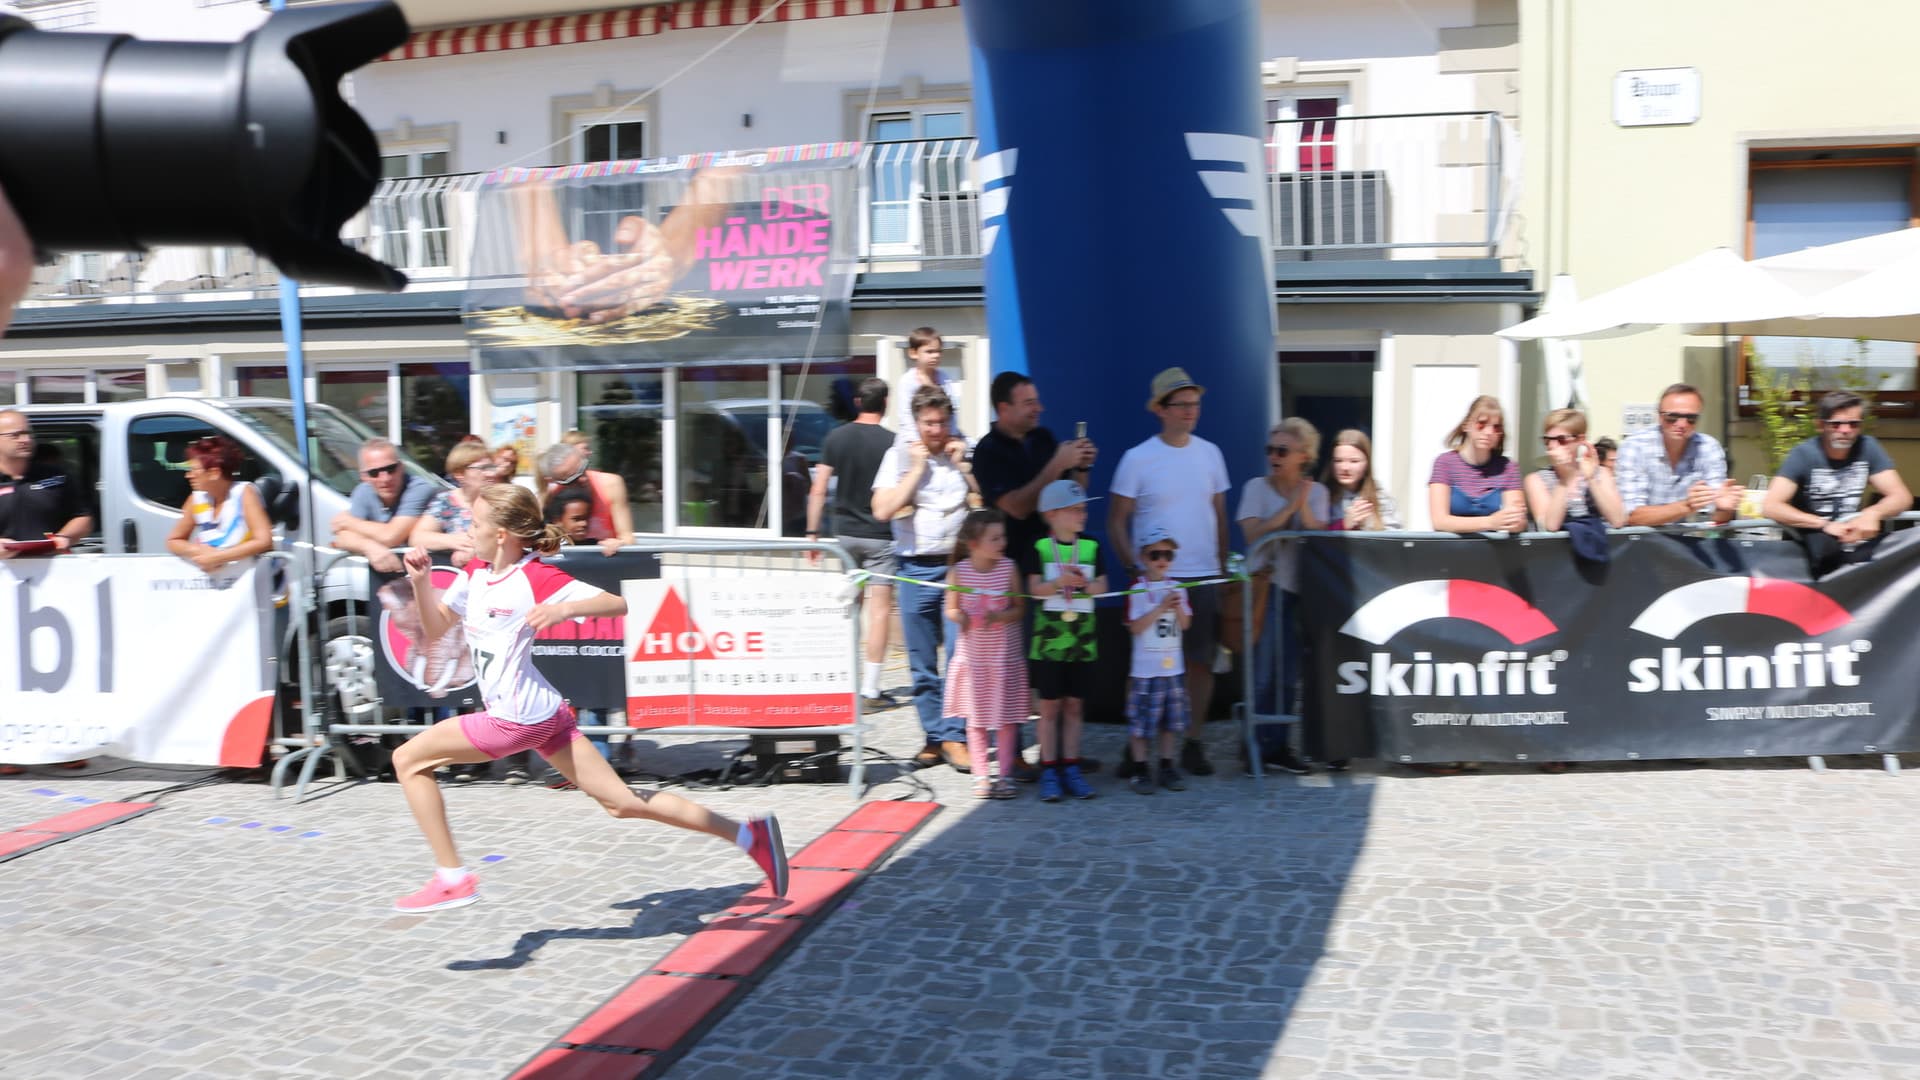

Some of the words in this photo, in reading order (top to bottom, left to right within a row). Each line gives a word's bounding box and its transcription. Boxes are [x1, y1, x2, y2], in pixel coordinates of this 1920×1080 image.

[762, 184, 829, 219] DER
[710, 256, 826, 291] WERK
[644, 630, 765, 655] HOGE
[1337, 650, 1559, 697] skinfit
[1628, 643, 1862, 693] skinfit
